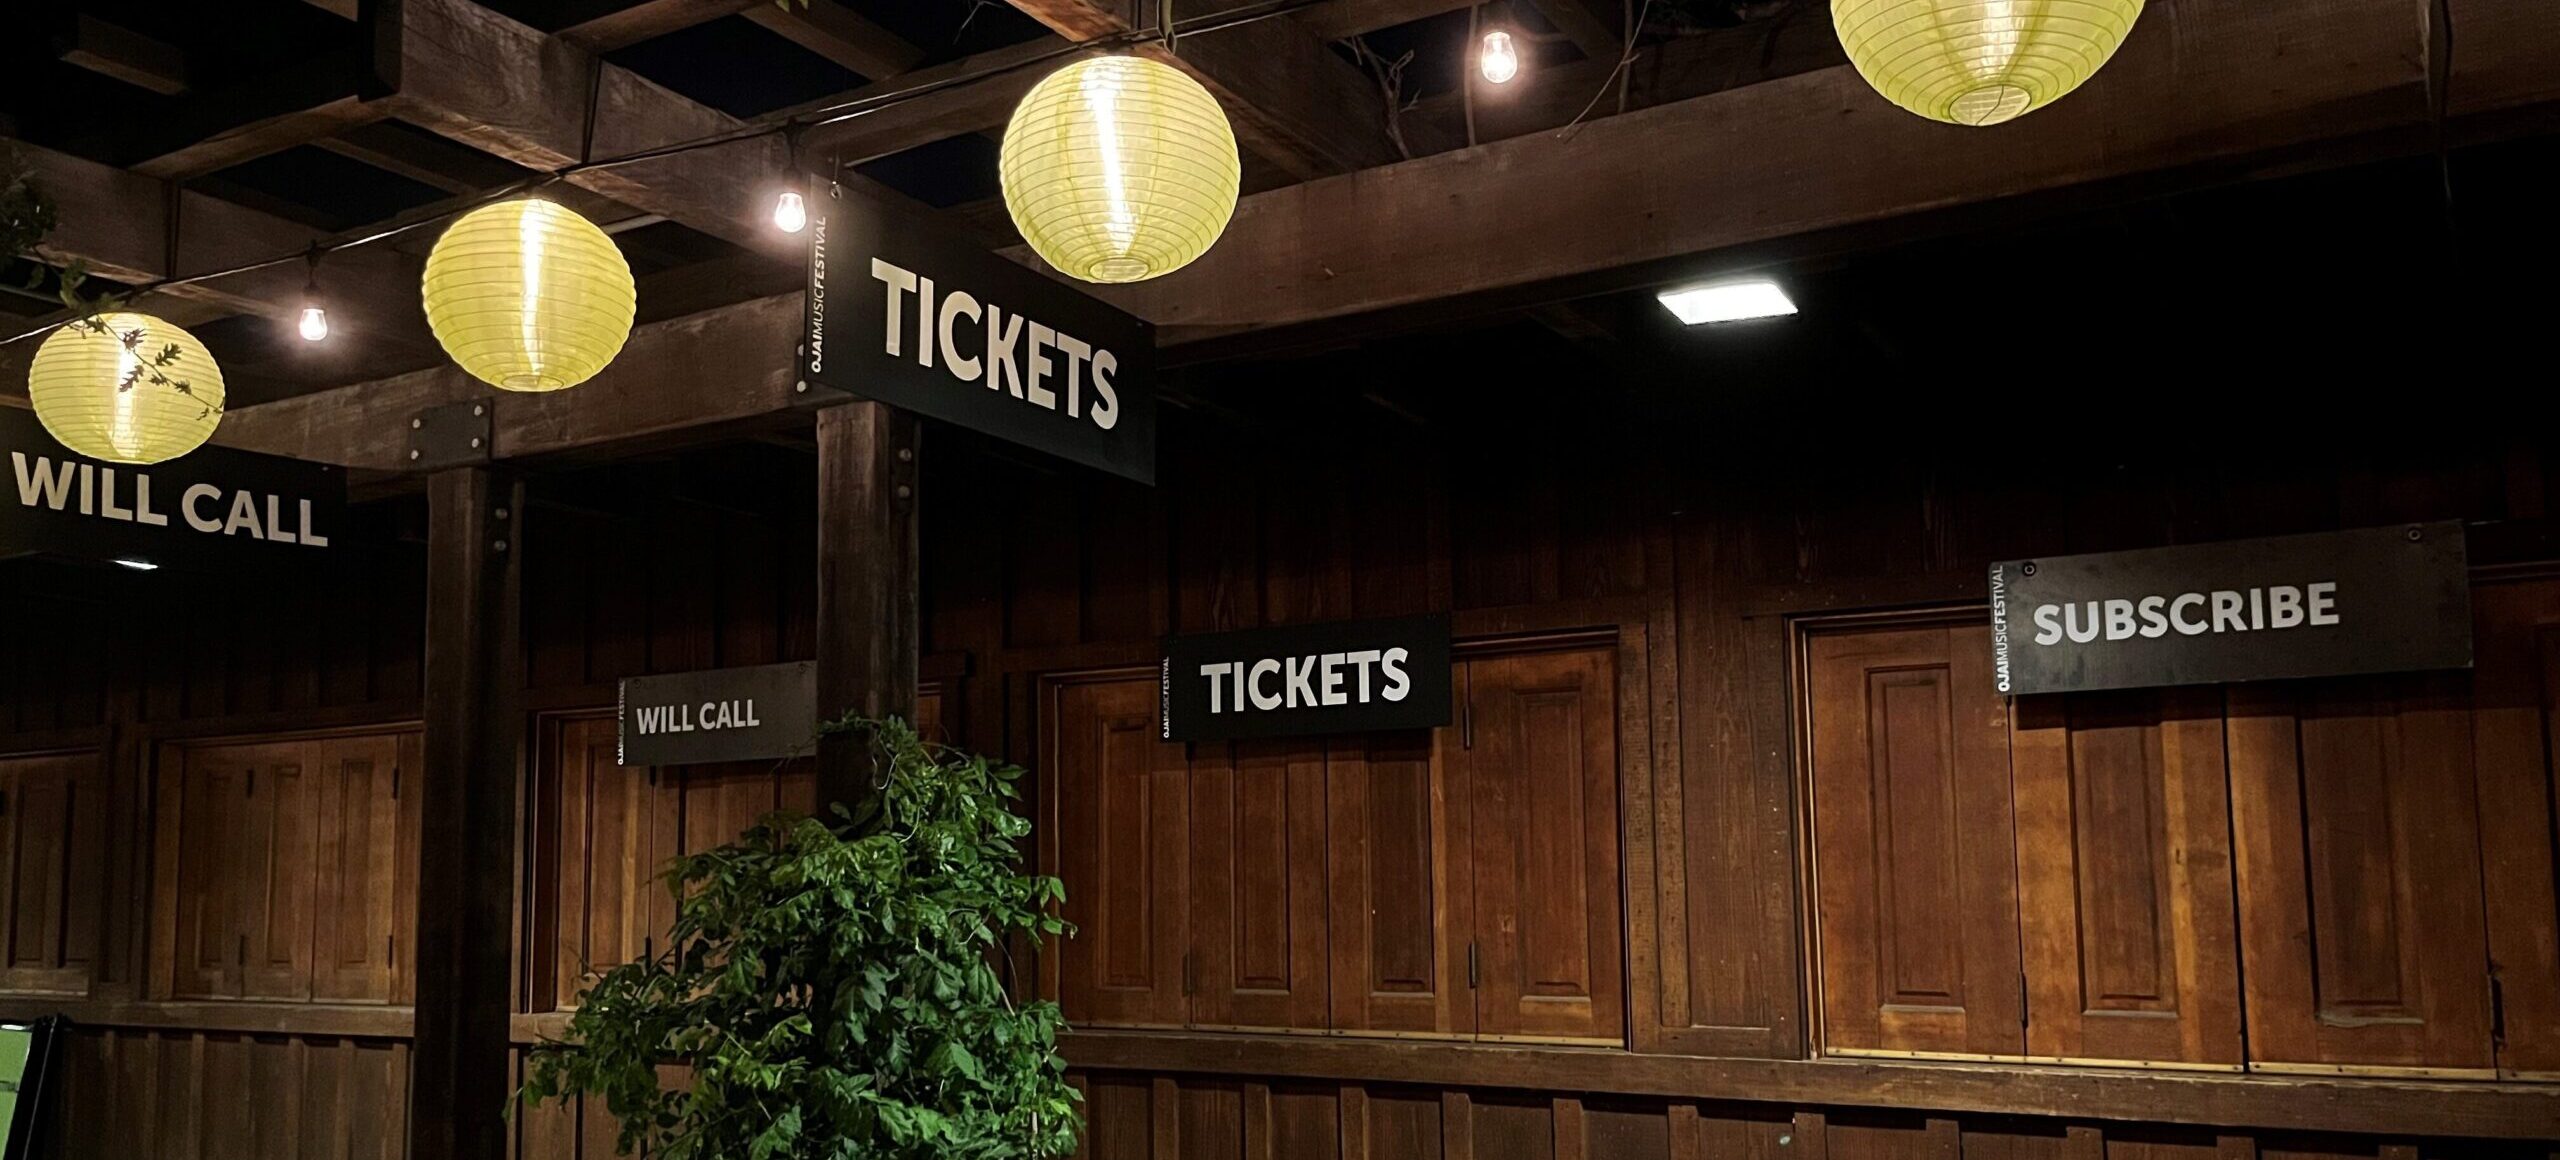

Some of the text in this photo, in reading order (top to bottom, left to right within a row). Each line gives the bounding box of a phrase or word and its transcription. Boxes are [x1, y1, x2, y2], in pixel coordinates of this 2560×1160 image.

[871, 256, 1119, 430] TICKETS
[11, 451, 328, 547] WILL CALL
[2033, 582, 2340, 646] SUBSCRIBE
[1200, 647, 1411, 714] TICKETS
[636, 699, 760, 735] WILL CALL
